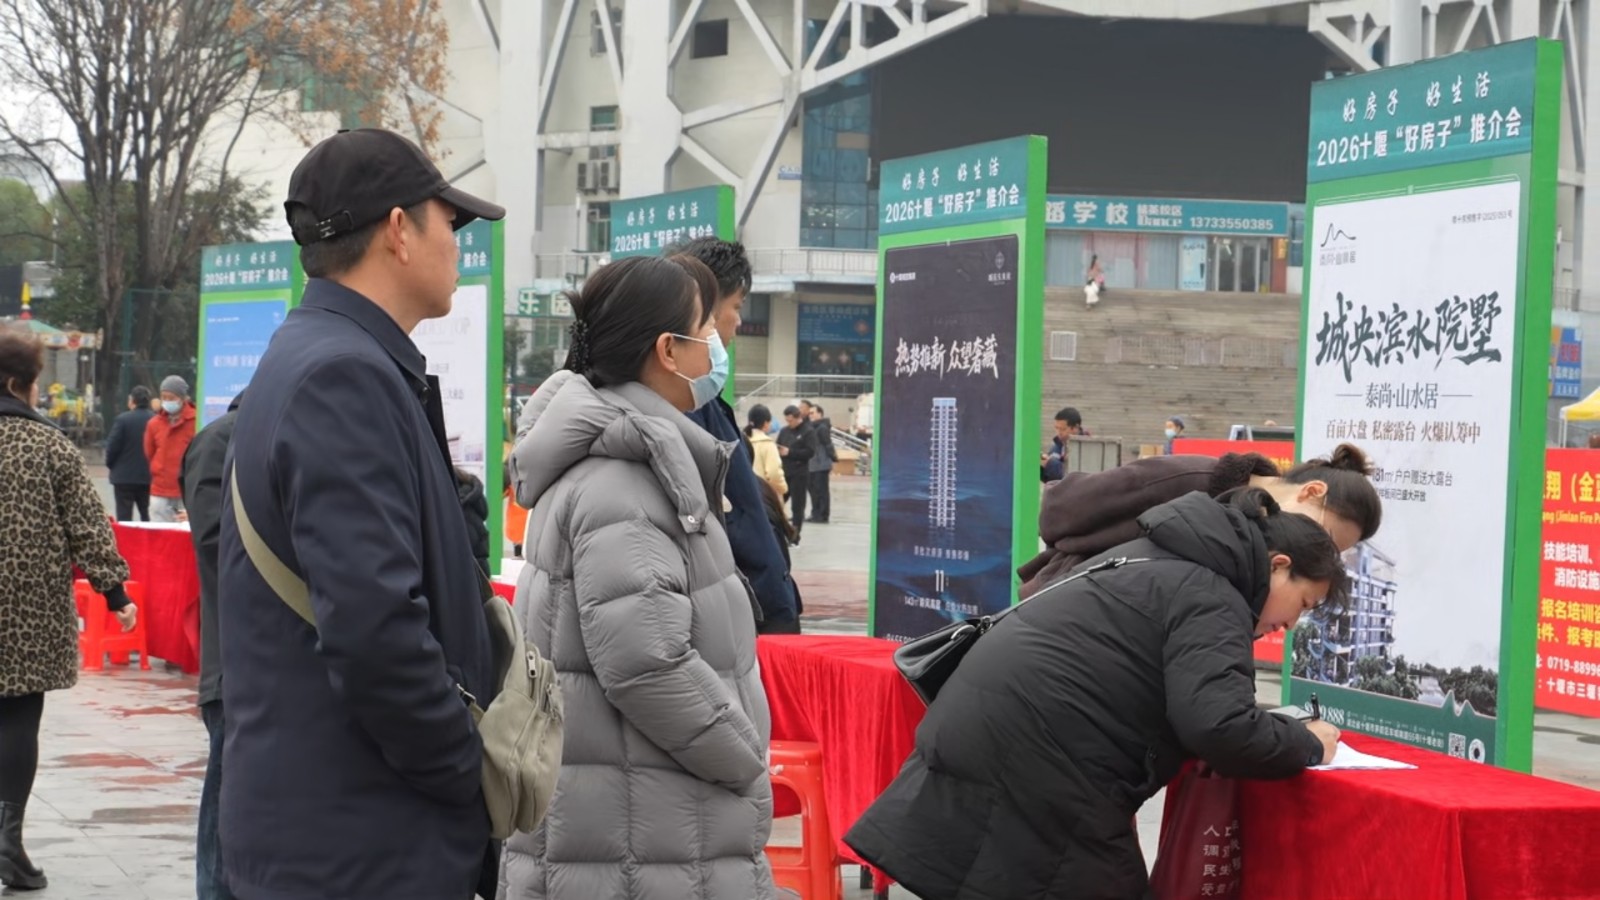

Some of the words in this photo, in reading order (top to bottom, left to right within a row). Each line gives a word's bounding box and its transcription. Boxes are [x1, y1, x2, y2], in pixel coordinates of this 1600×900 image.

[1343, 91, 1399, 123] 好房子
[1425, 71, 1491, 108] 好生活
[902, 167, 940, 190] 好房子
[957, 157, 999, 181] 好生活
[1190, 216, 1274, 231] 13733550385
[1315, 291, 1502, 384] 城央滨水院墅
[1365, 382, 1439, 410] 泰尚·山水居
[1326, 419, 1367, 440] 百亩大盘
[1372, 420, 1416, 443] 私密露台
[1420, 421, 1481, 445] 火爆认筹中
